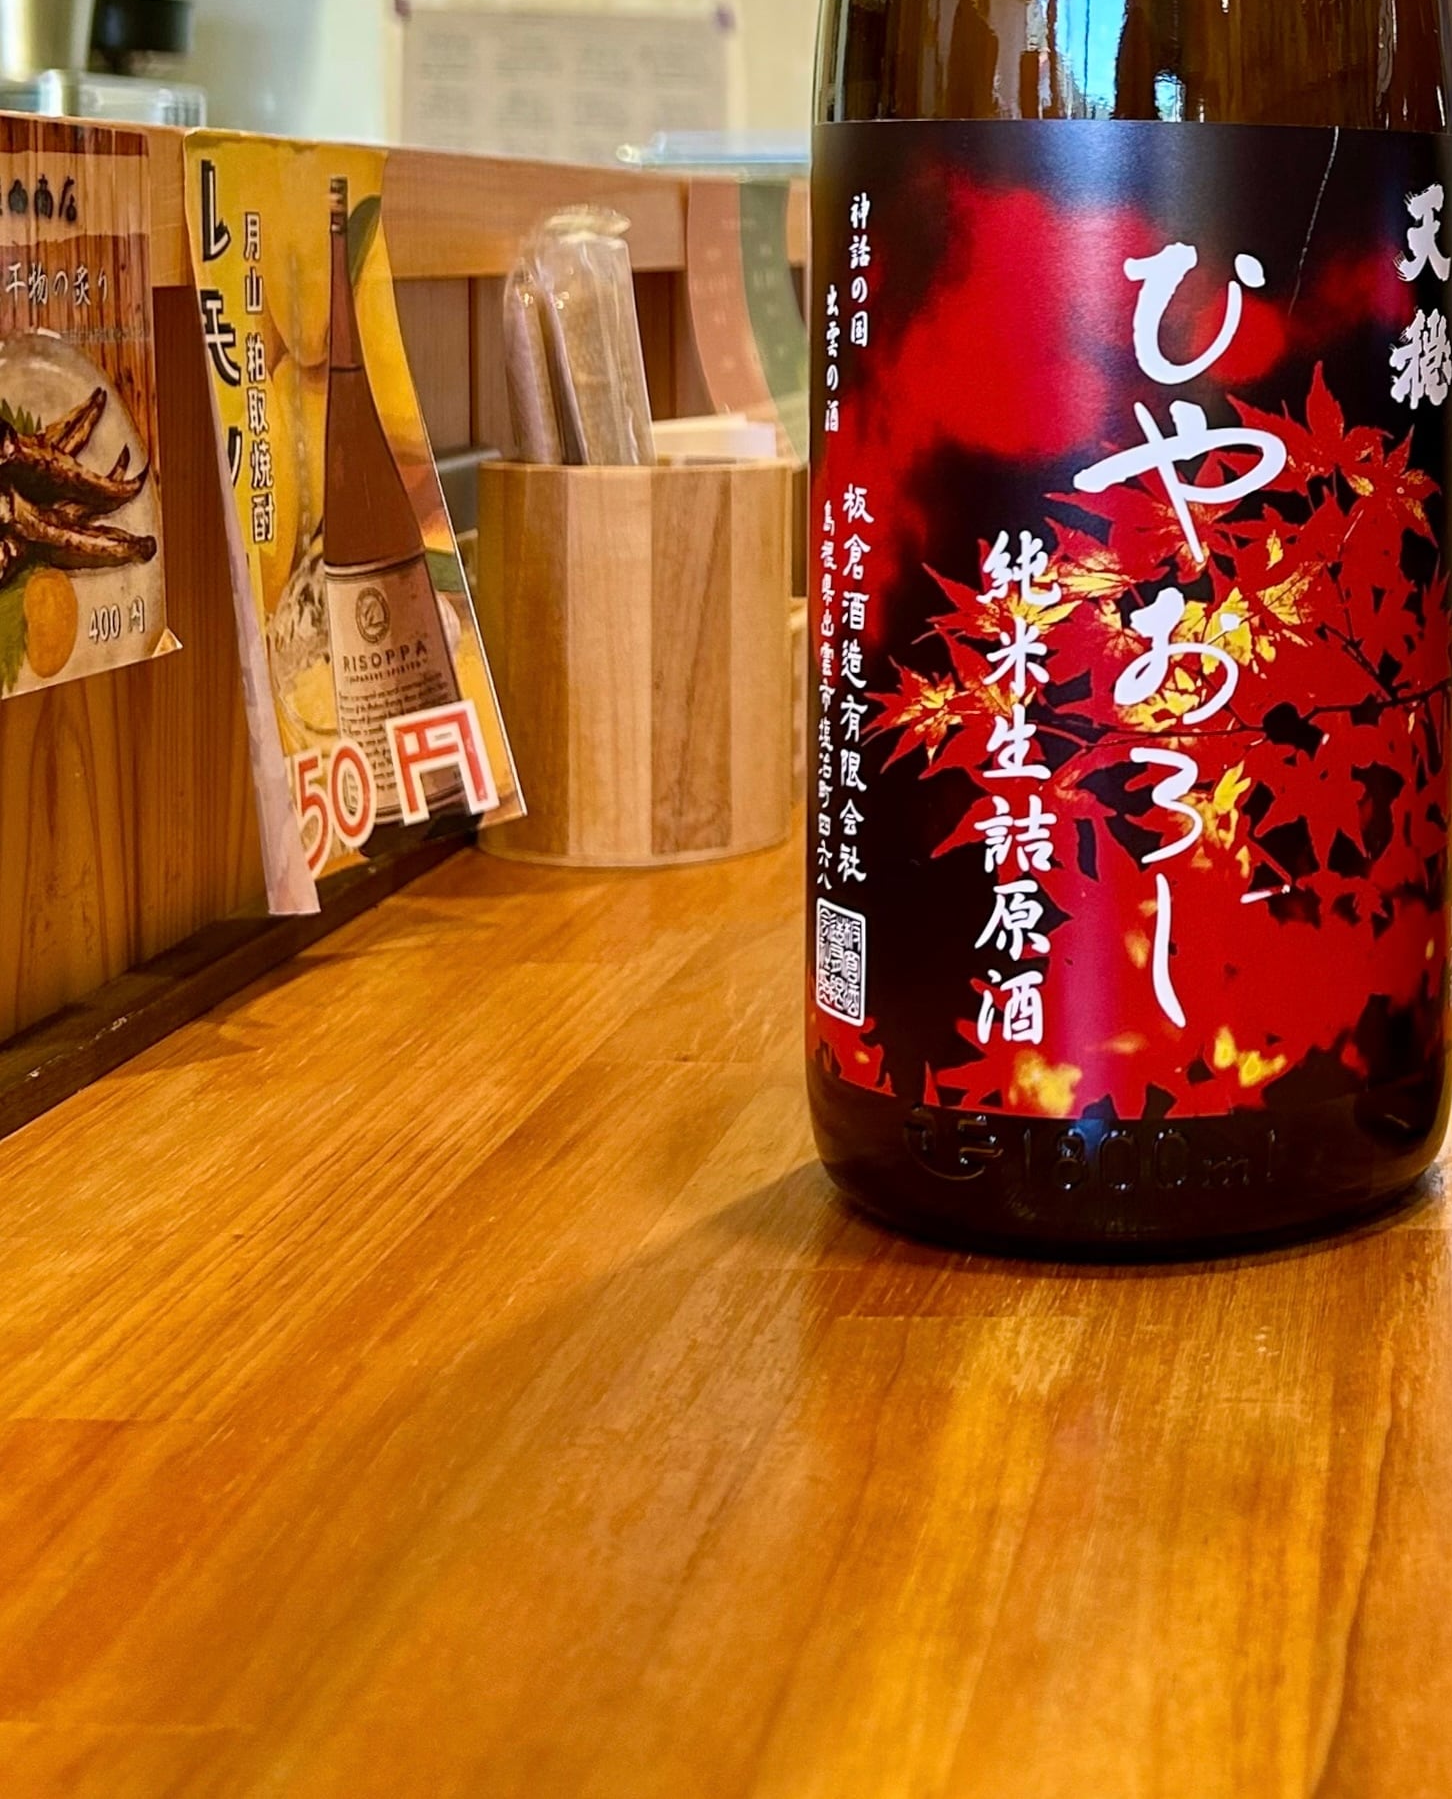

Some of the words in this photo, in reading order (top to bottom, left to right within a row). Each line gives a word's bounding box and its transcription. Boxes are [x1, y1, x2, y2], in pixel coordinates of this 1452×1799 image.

[243, 211, 265, 315] 月山
[849, 192, 871, 348] 神話の国
[825, 284, 841, 432] 出雲の酒
[88, 603, 122, 644] 400
[342, 639, 429, 674] RISOPPA
[837, 483, 874, 883] 板倉酒造有限会社
[1073, 242, 1287, 1028] ひやおろし
[974, 529, 1063, 1046] 純米生詰原酒
